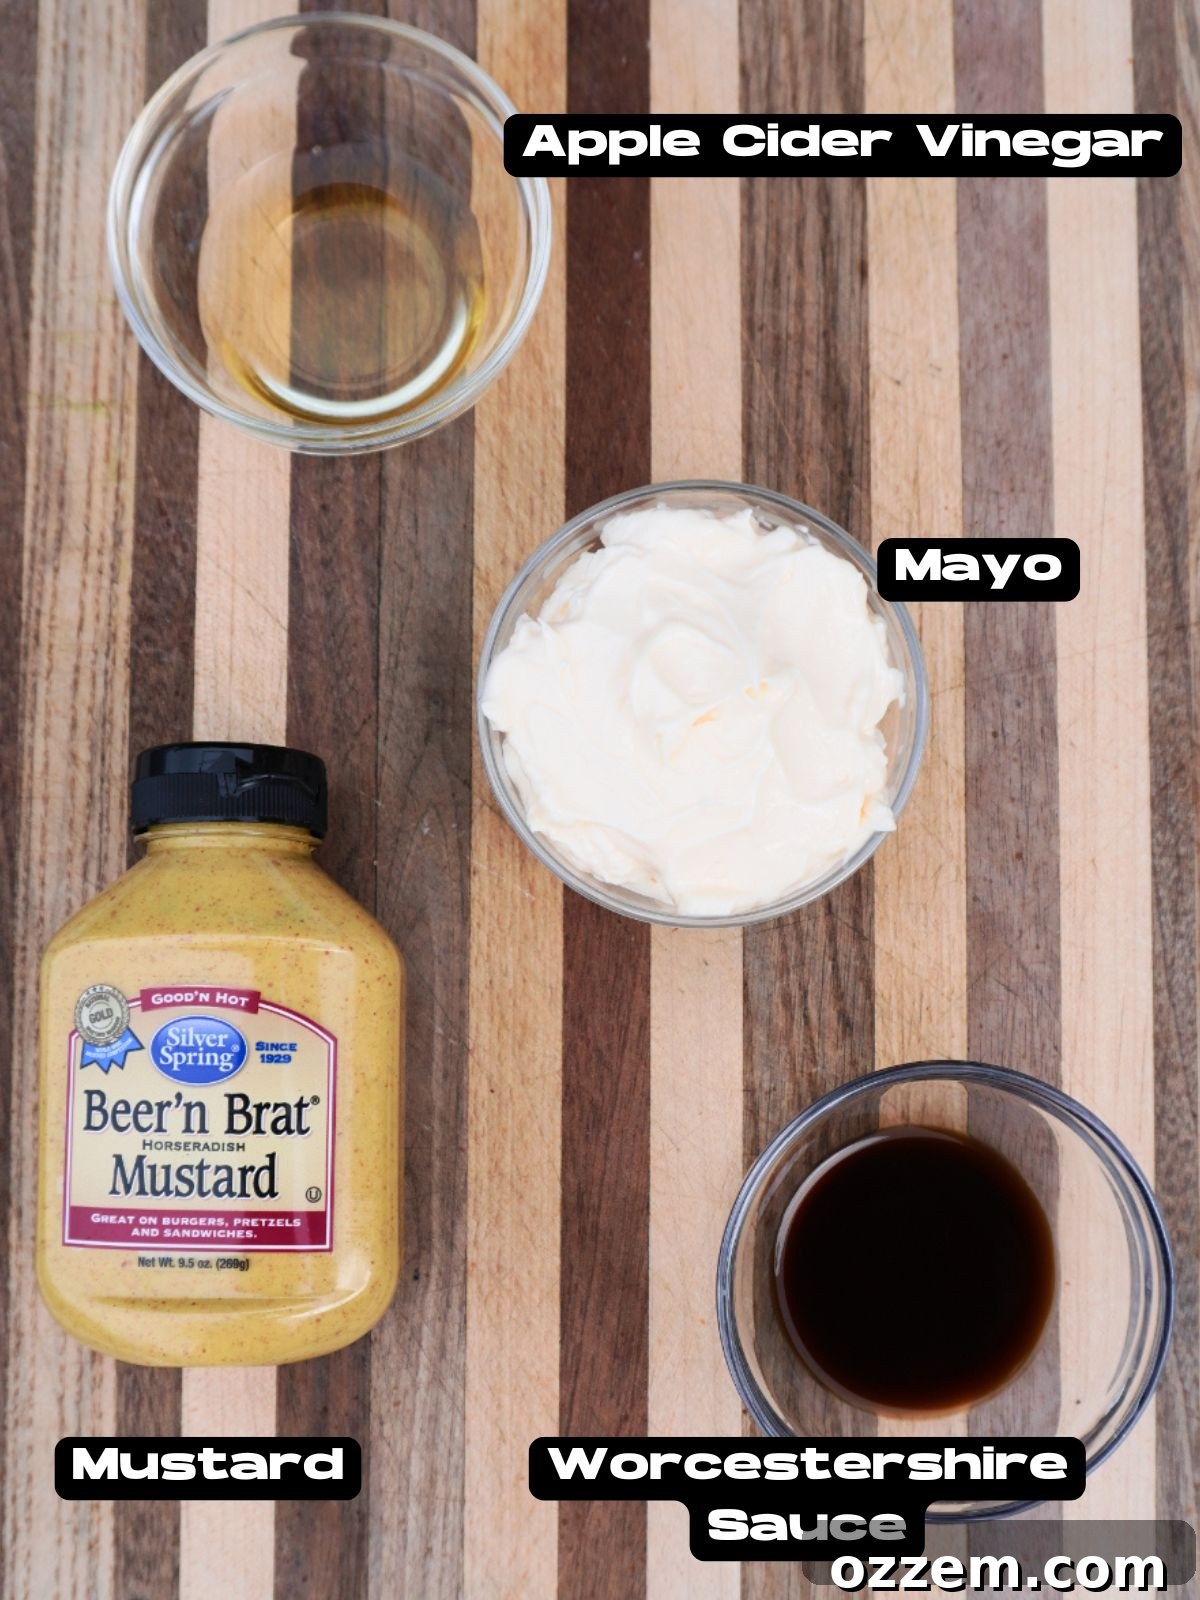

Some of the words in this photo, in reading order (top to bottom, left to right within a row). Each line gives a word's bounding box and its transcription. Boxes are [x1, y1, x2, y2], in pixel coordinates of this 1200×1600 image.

[88, 1007, 114, 1024] GOLD
[166, 1026, 229, 1049] Silver
[255, 1041, 297, 1052] SINCE
[260, 1054, 292, 1064] 1929
[83, 1089, 210, 1133] Beer'n
[142, 1139, 246, 1153] HORSERADISH
[108, 1152, 279, 1199] Mustard
[131, 1228, 160, 1238] AND
[138, 1256, 155, 1268] Net
[178, 1258, 195, 1269] 9.5
